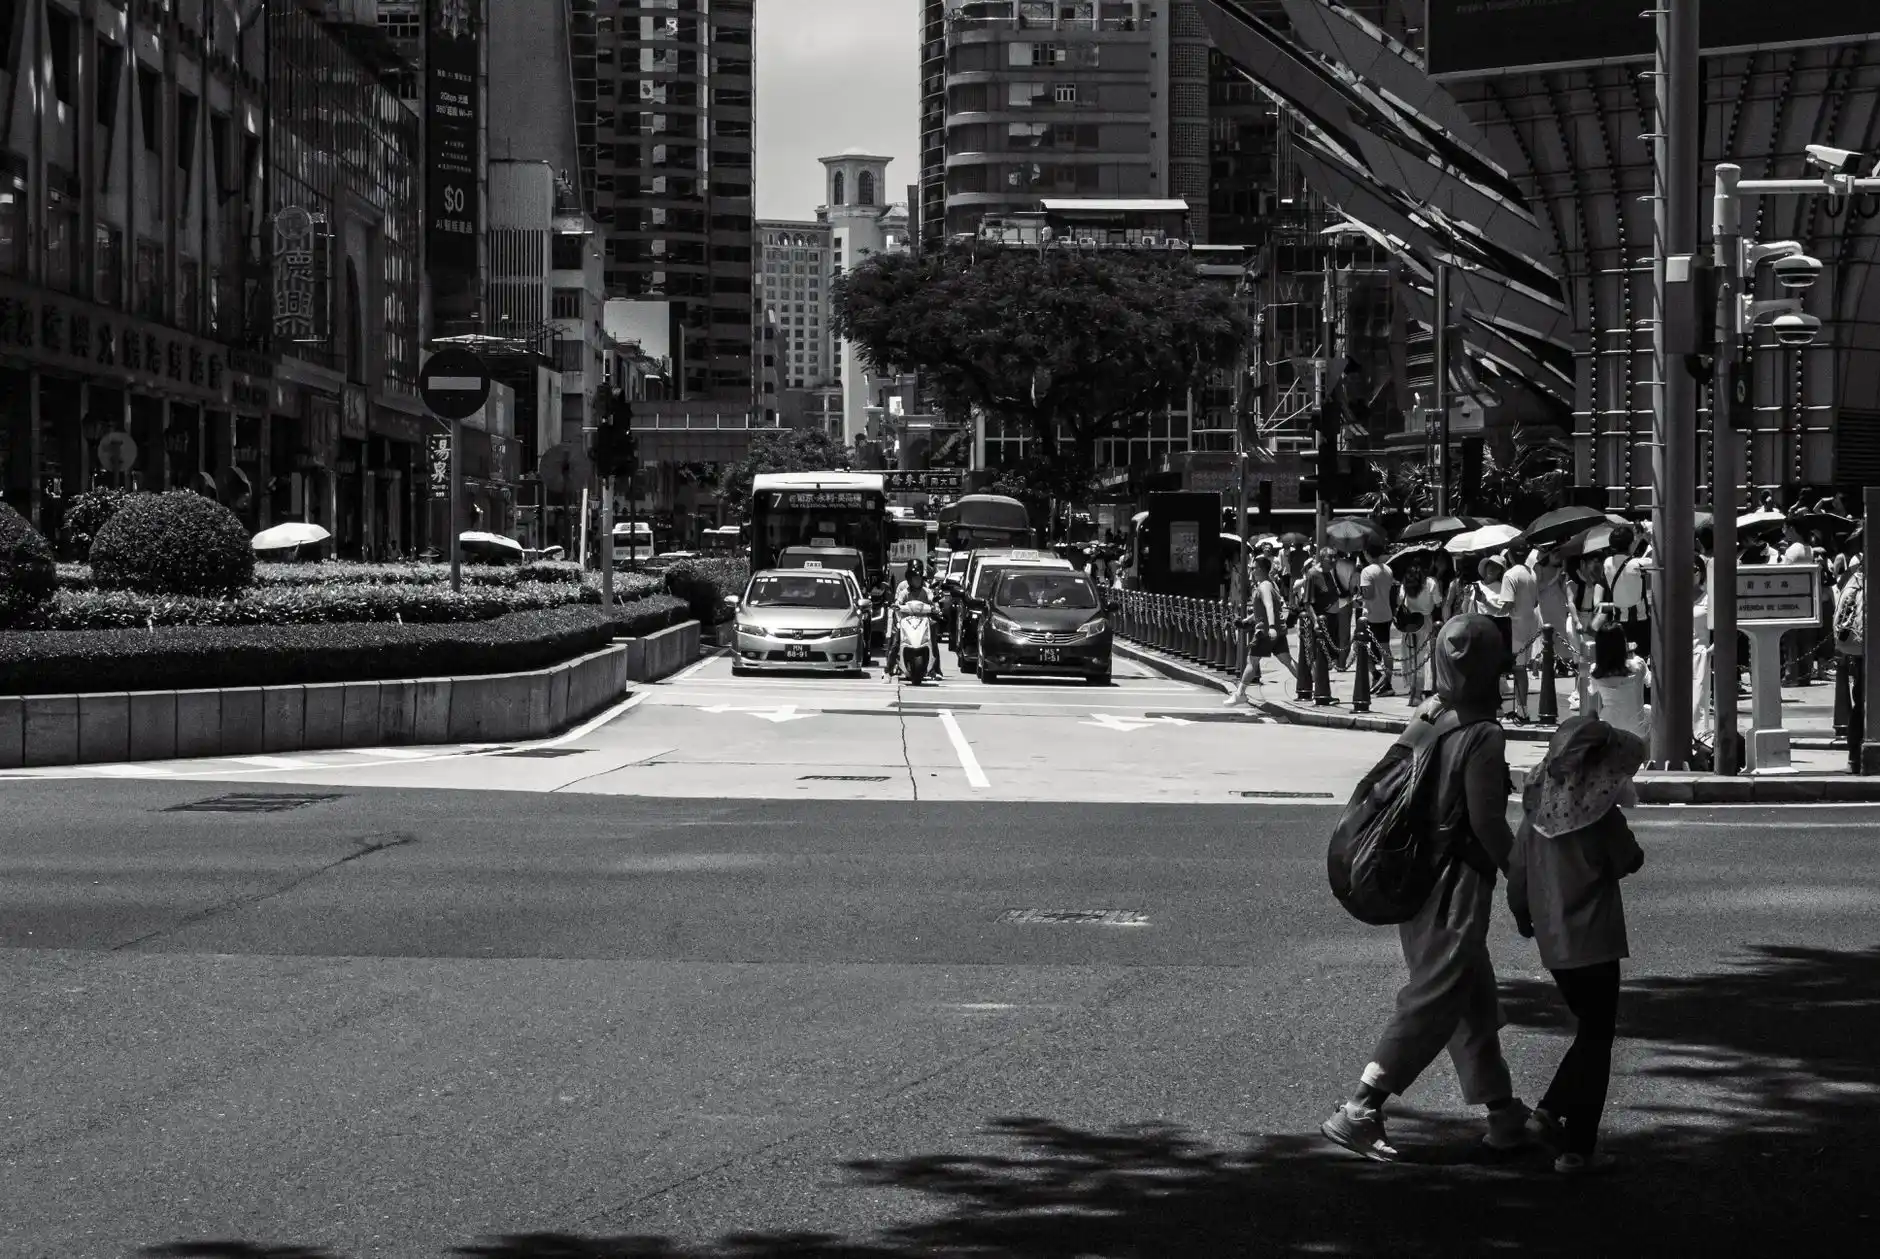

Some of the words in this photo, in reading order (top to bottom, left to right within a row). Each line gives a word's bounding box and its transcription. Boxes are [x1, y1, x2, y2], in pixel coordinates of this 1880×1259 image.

[444, 183, 464, 214] $0
[430, 439, 452, 483] 湯泉
[772, 492, 782, 508] 7
